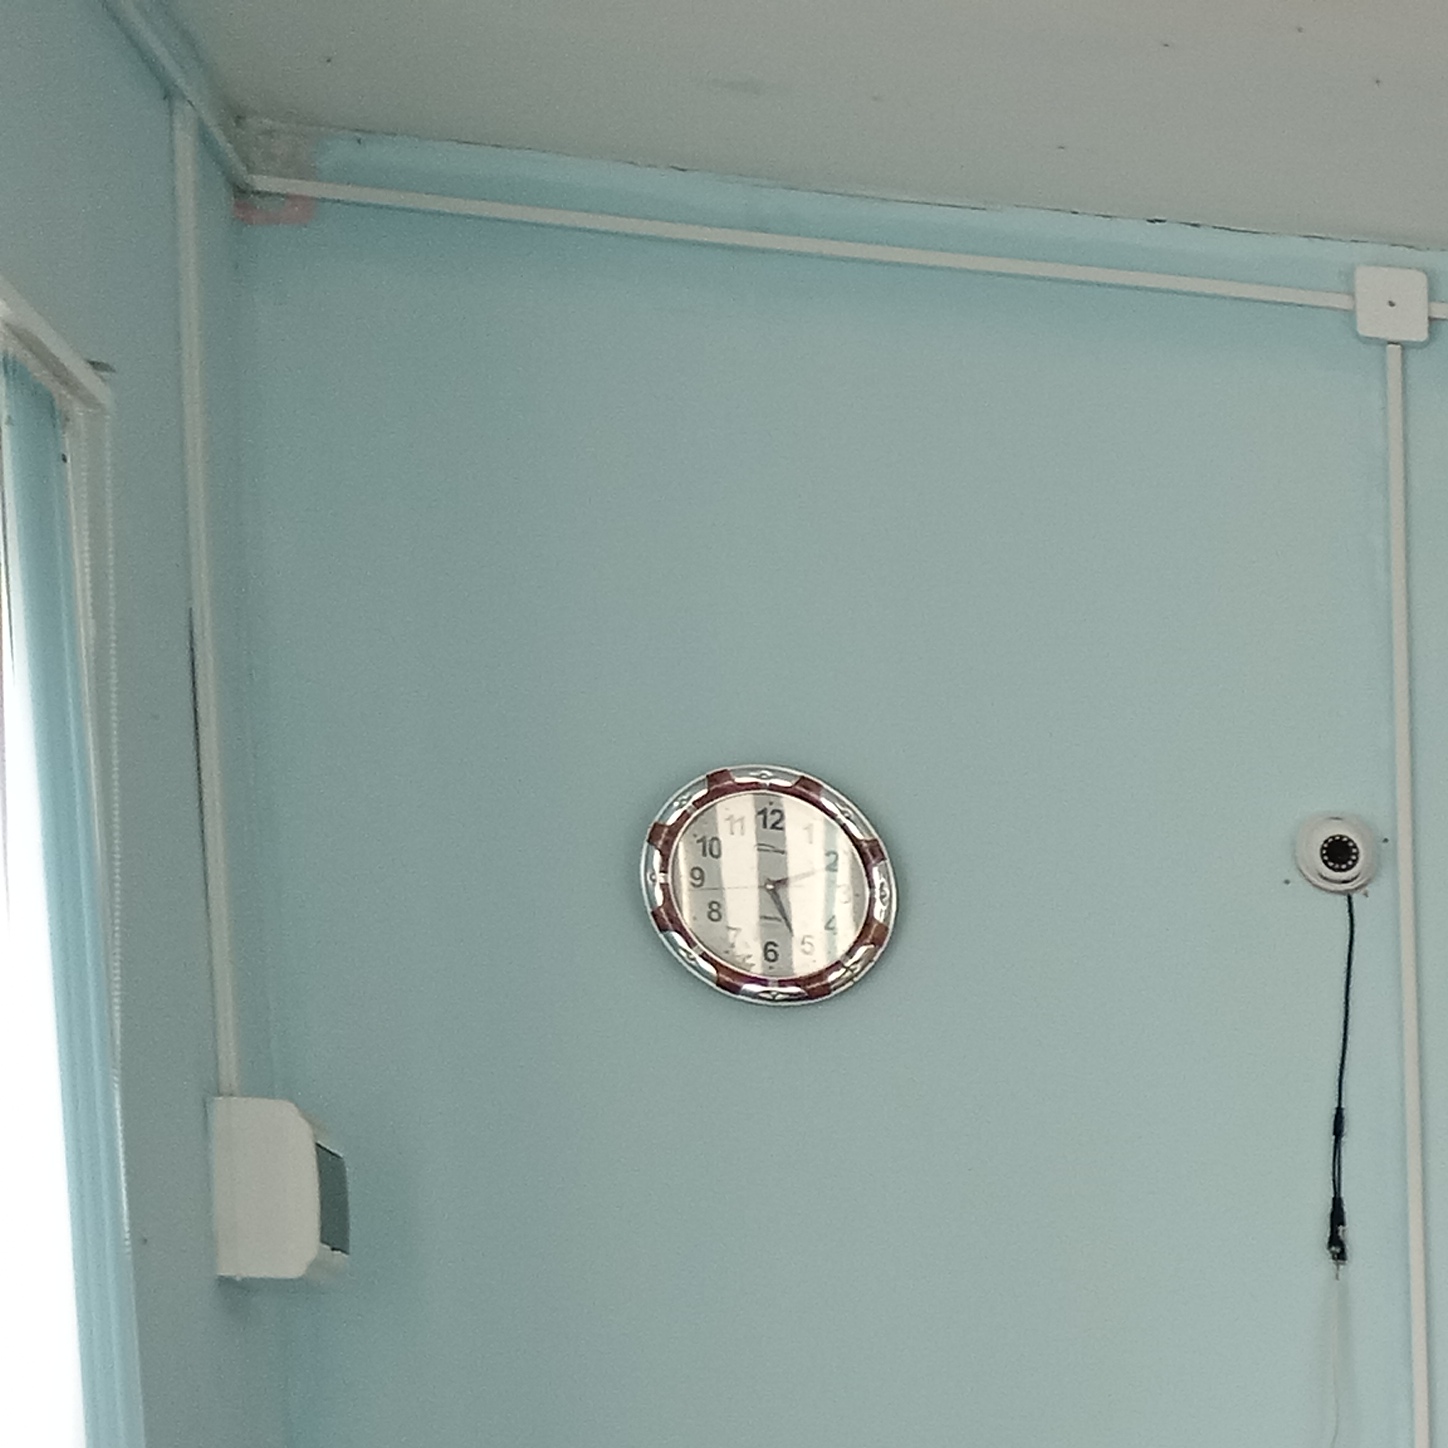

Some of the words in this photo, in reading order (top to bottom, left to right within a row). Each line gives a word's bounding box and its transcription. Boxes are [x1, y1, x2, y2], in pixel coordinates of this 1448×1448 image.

[757, 808, 785, 832] 12
[697, 835, 722, 860] 10
[825, 851, 840, 873] 2
[690, 866, 705, 888] 9
[706, 901, 723, 922] 8
[763, 941, 780, 963] 6
